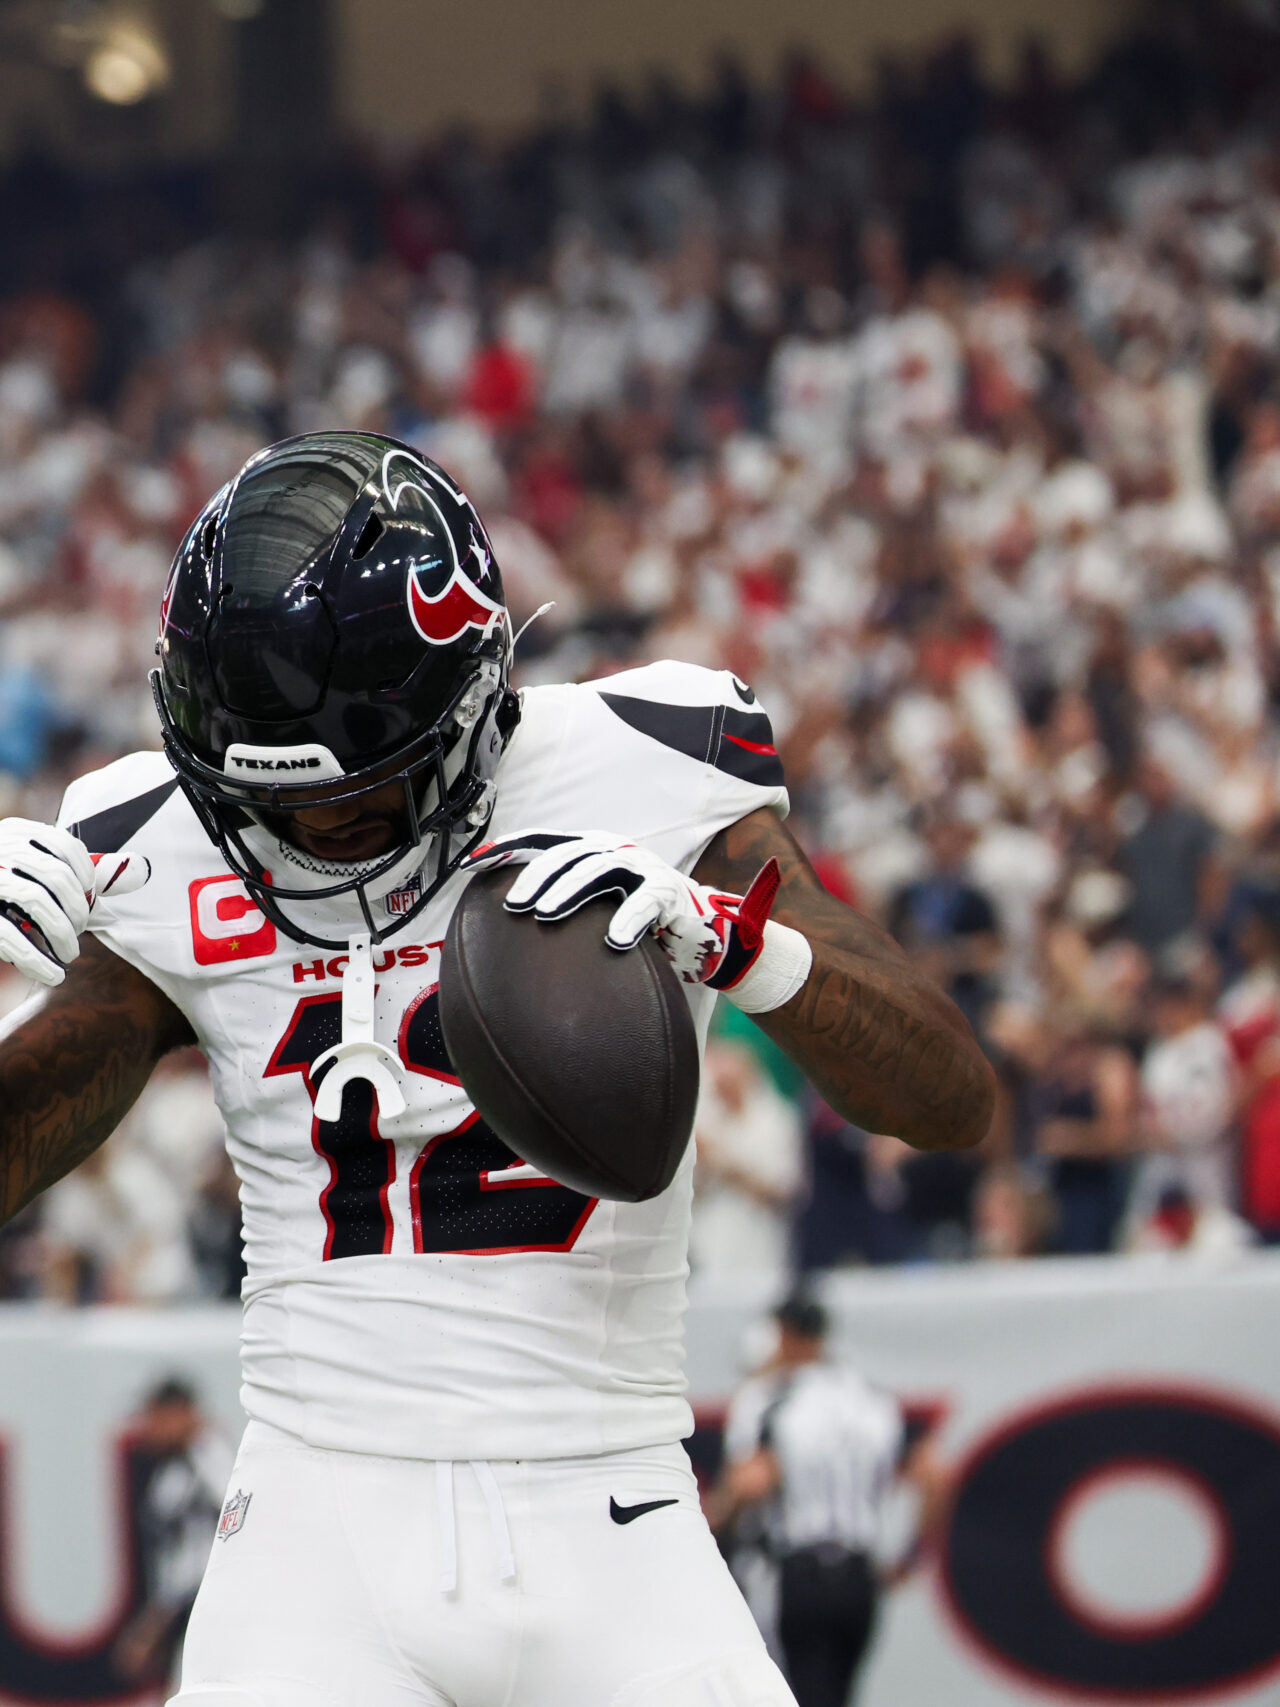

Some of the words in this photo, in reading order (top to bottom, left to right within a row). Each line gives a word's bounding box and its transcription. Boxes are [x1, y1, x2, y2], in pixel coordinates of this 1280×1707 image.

[231, 756, 321, 770] TEXANS
[292, 940, 445, 984] HOUS
[262, 980, 599, 1262] 12
[220, 1510, 239, 1531] NFL
